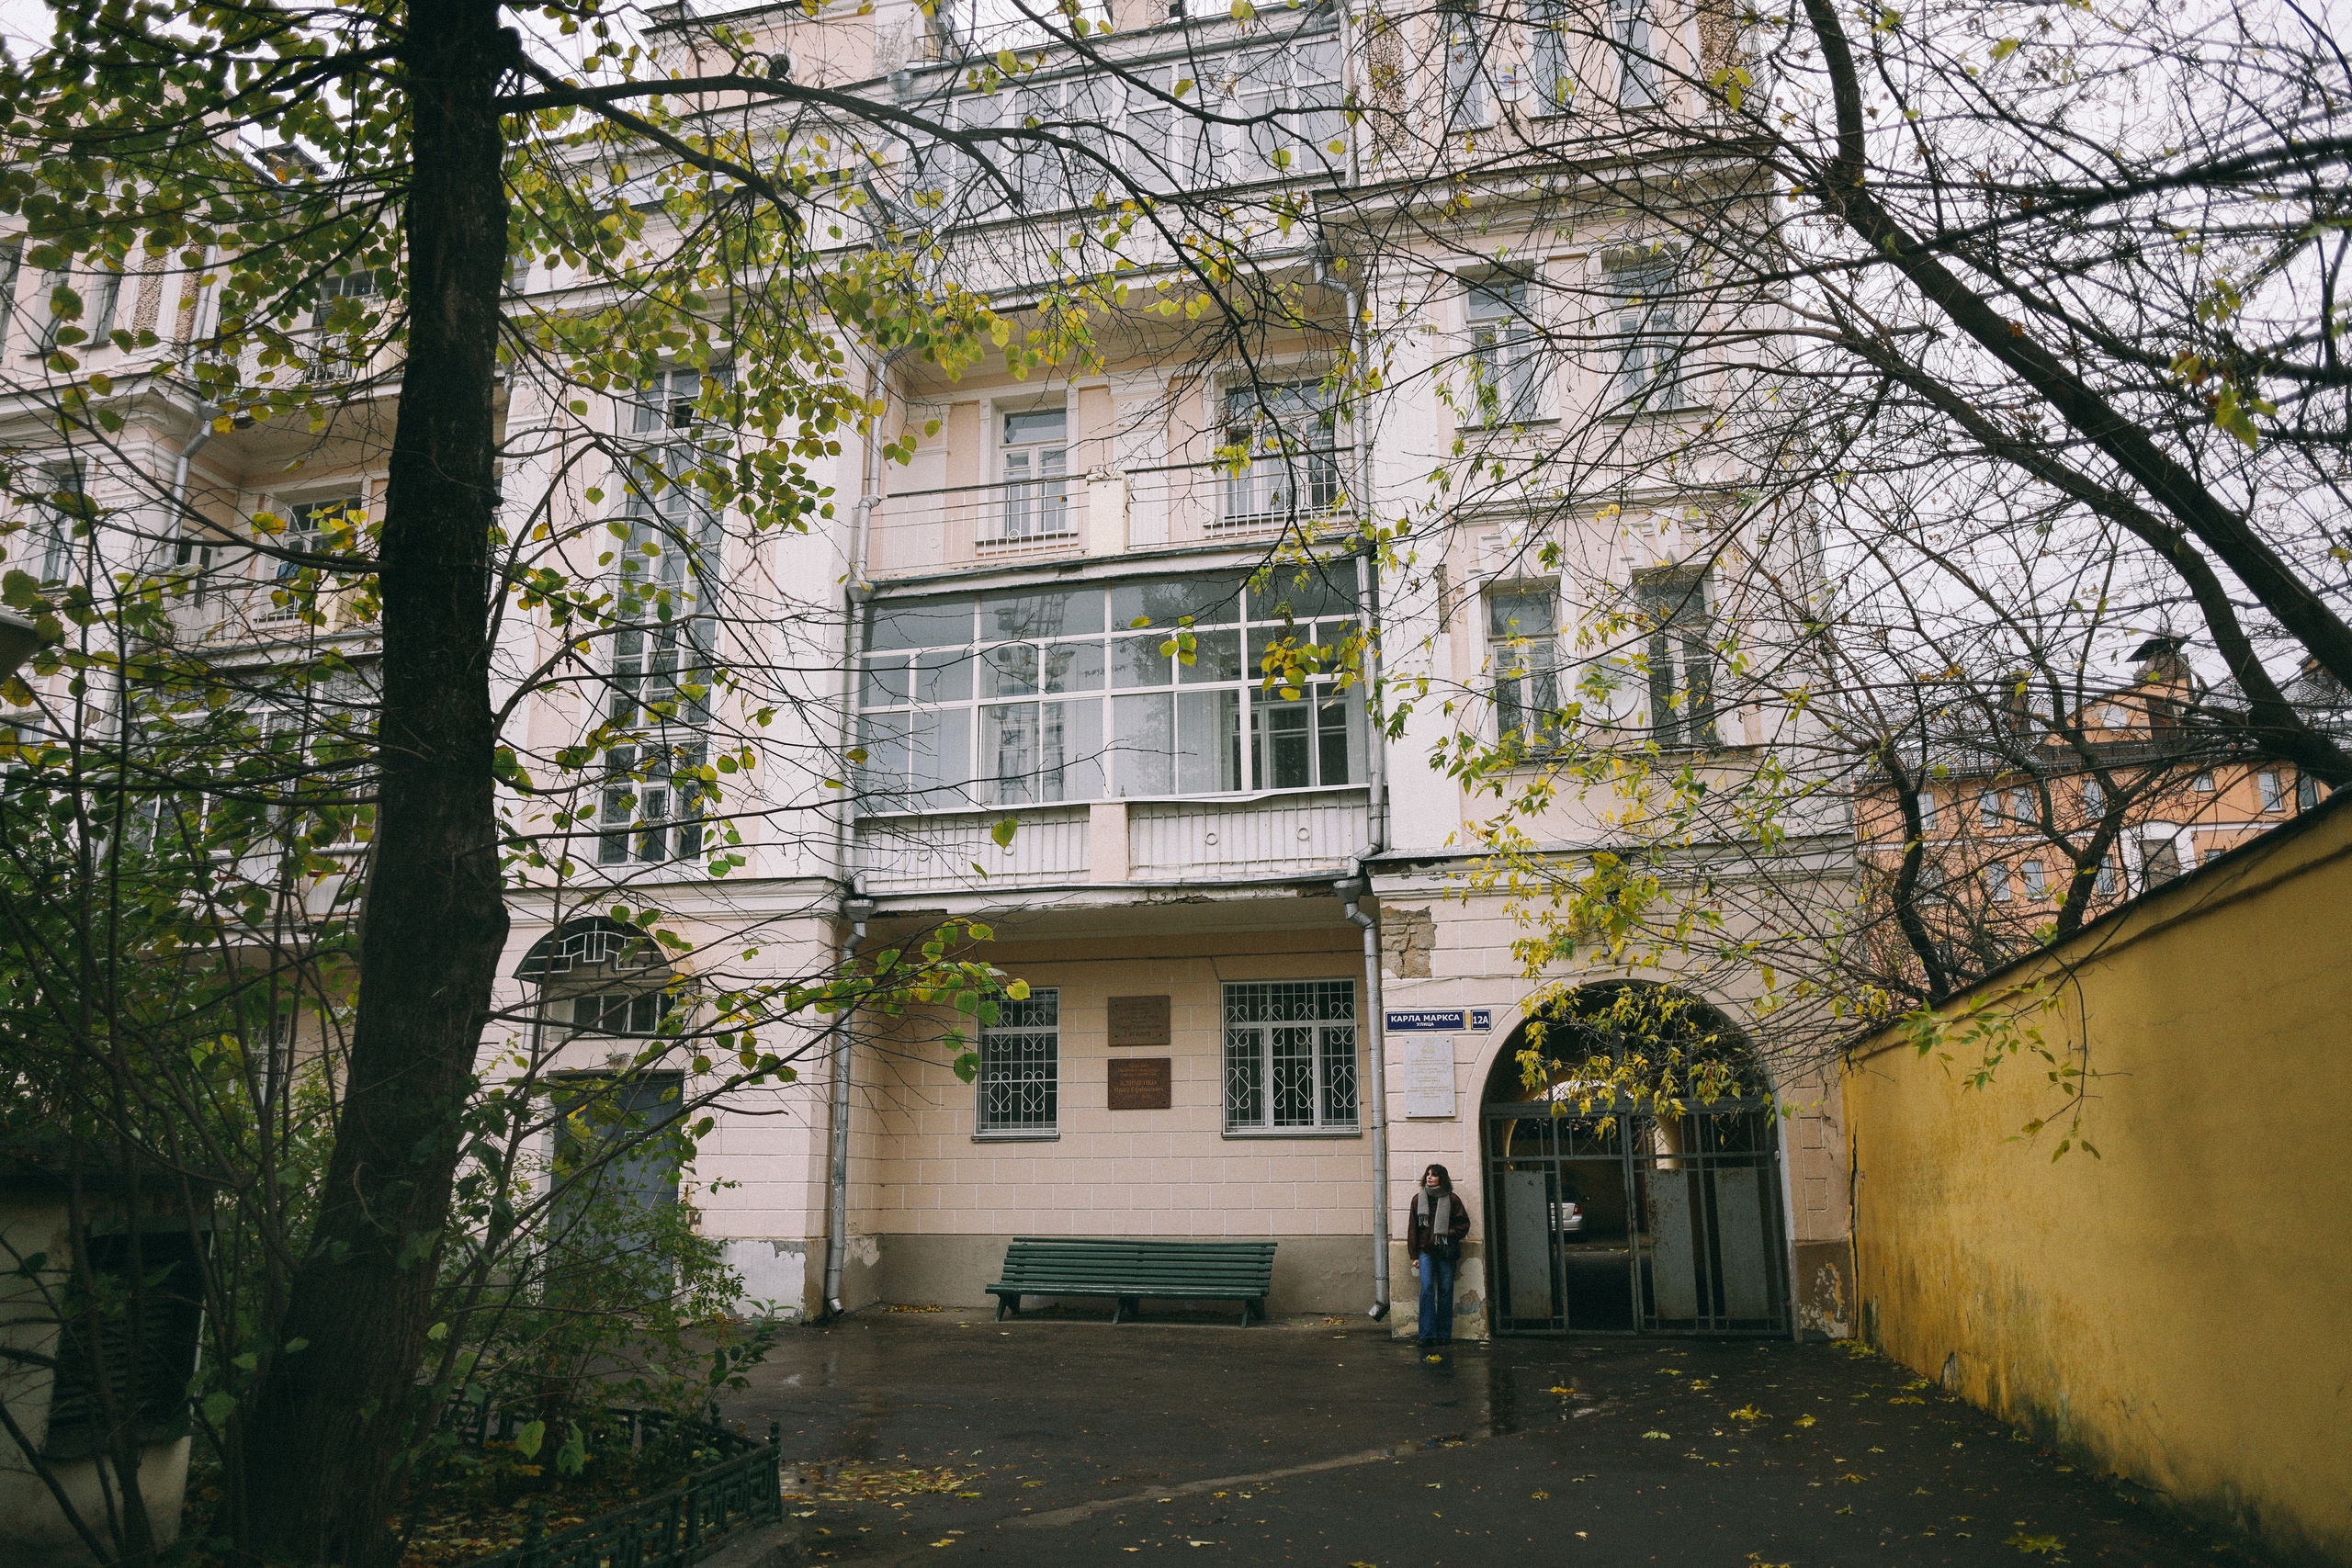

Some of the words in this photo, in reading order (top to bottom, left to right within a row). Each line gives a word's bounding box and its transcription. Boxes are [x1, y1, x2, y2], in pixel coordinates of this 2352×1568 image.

[1390, 1014, 1420, 1022] КАРЛА
[1423, 1013, 1460, 1021] МАРКСА
[1473, 1015, 1488, 1024] 12А
